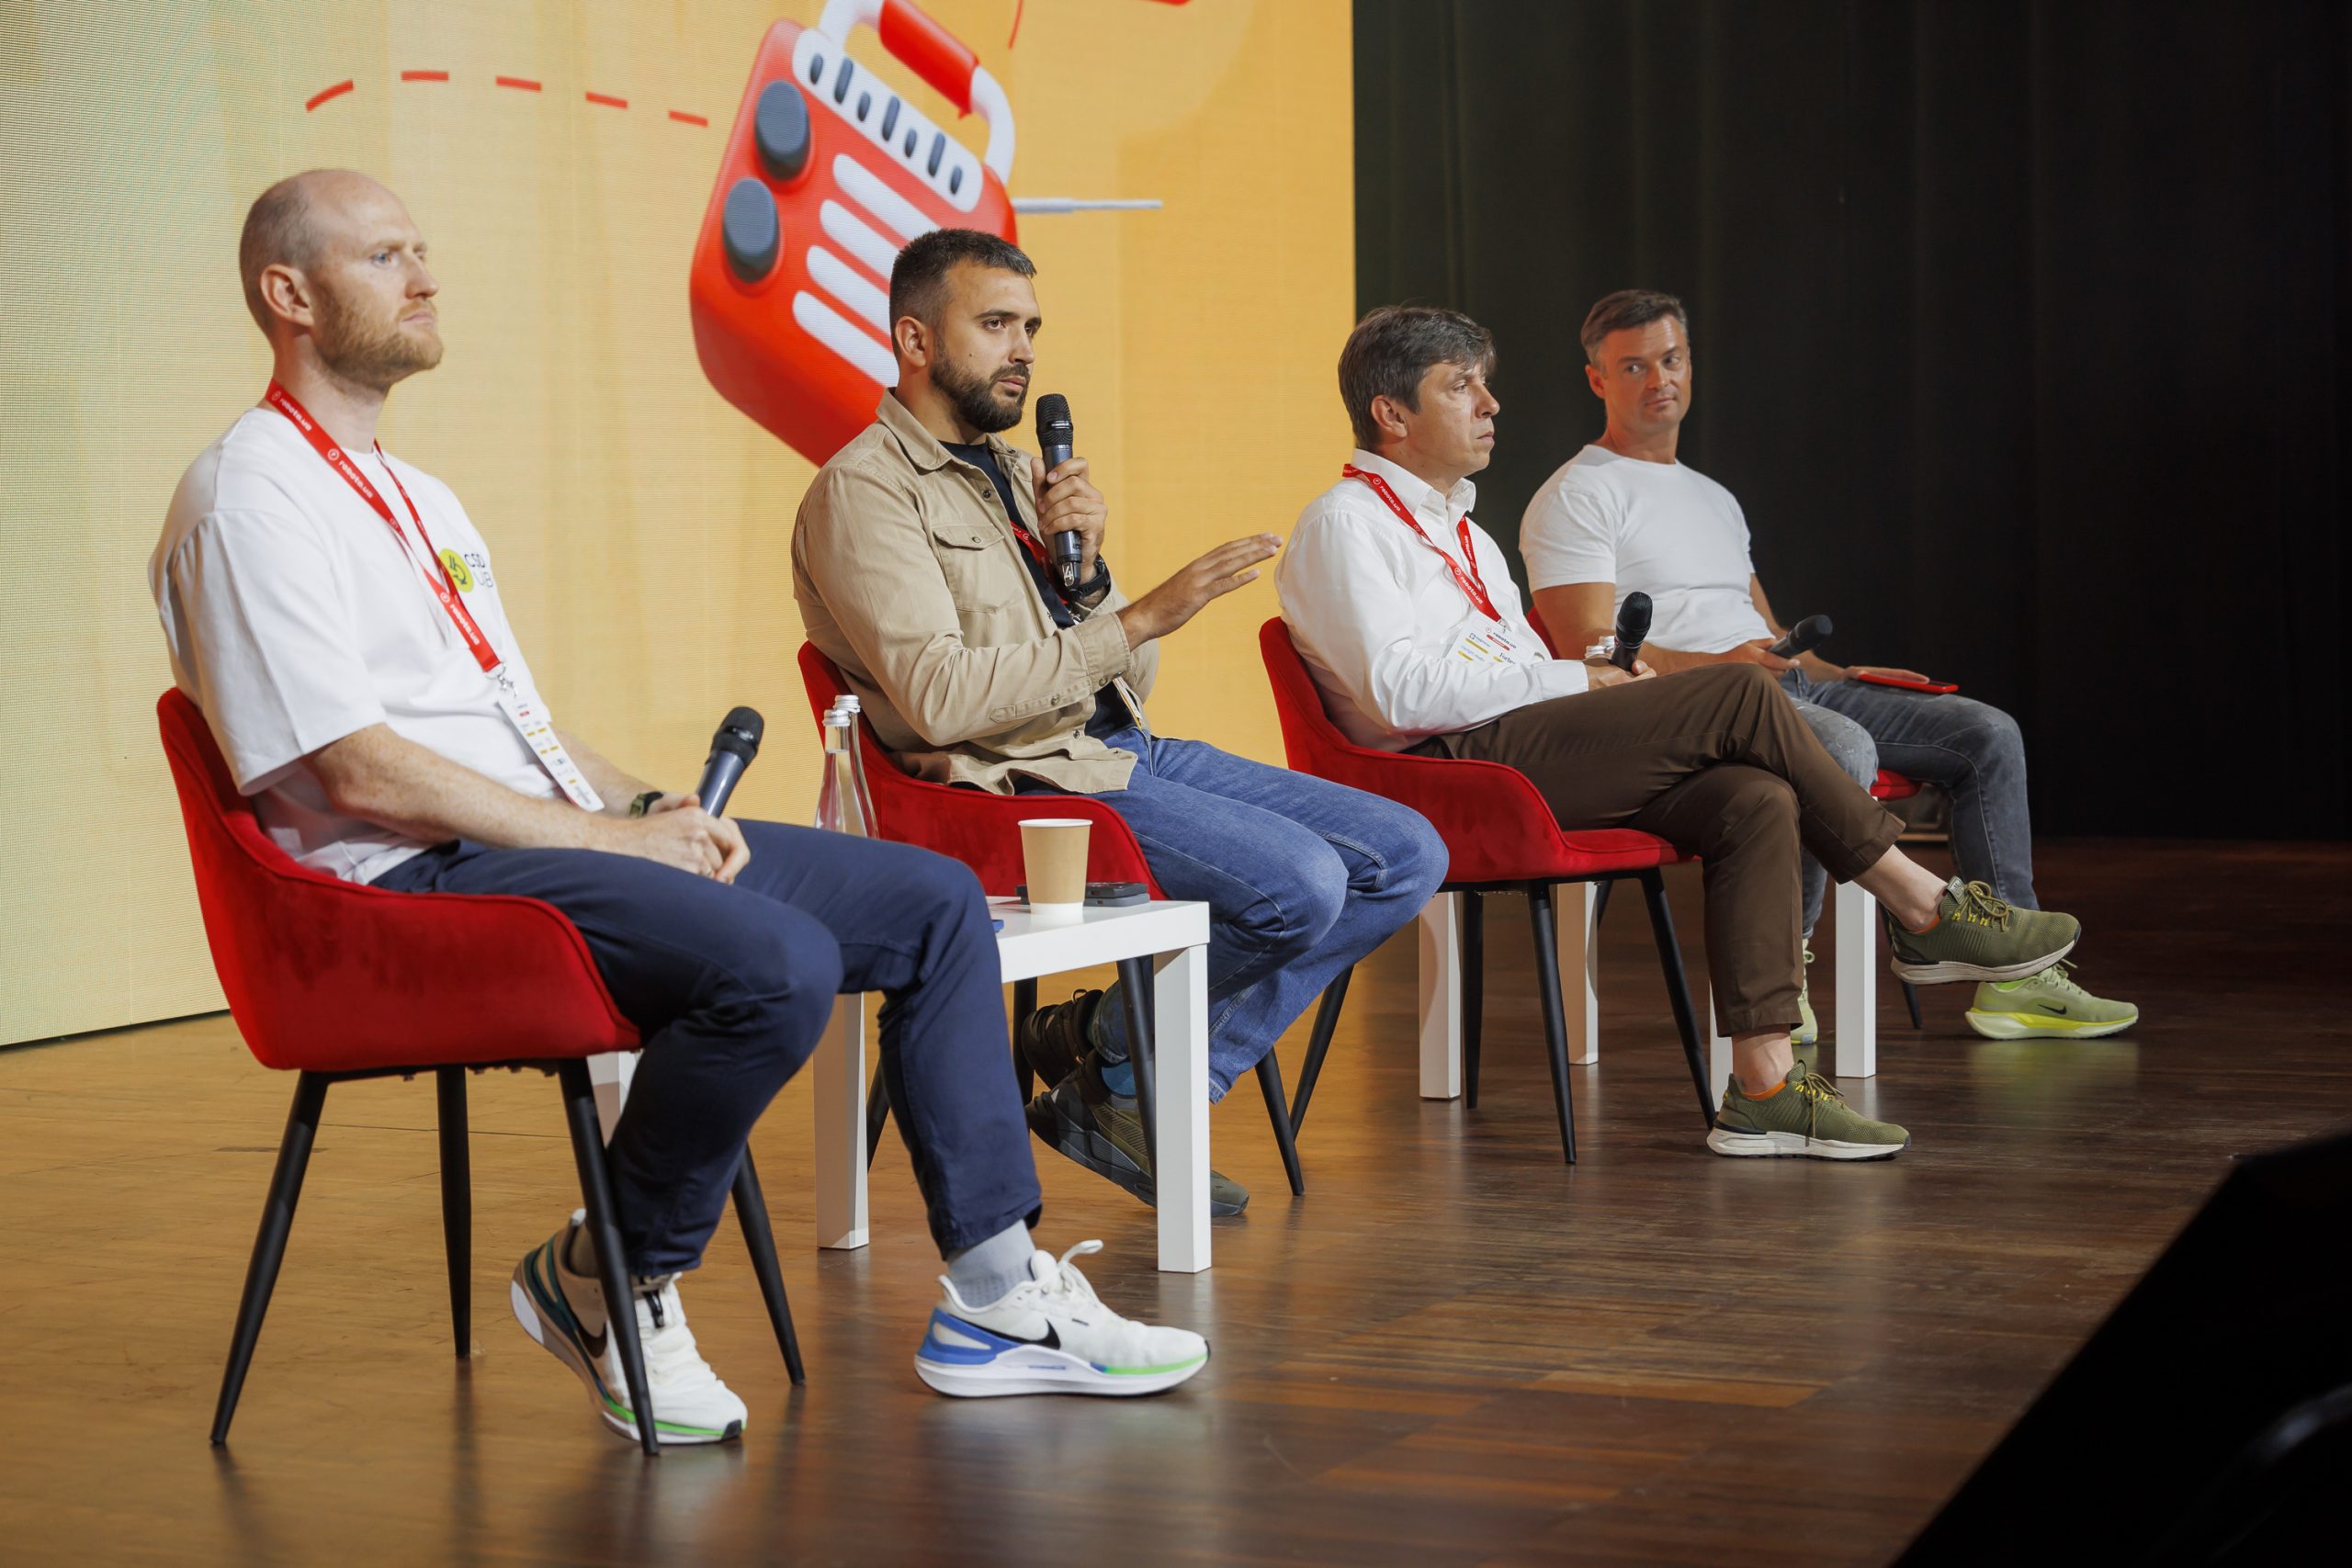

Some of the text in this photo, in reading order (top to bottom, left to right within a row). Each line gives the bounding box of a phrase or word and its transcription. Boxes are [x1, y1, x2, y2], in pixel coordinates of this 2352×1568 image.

[279, 398, 312, 432] robota.ua
[337, 460, 374, 499] robota.ua
[1379, 486, 1401, 512] robota.ua
[1460, 577, 1483, 604] robota.ua
[449, 603, 481, 647] robota.ua
[1493, 632, 1516, 649] robota.ua
